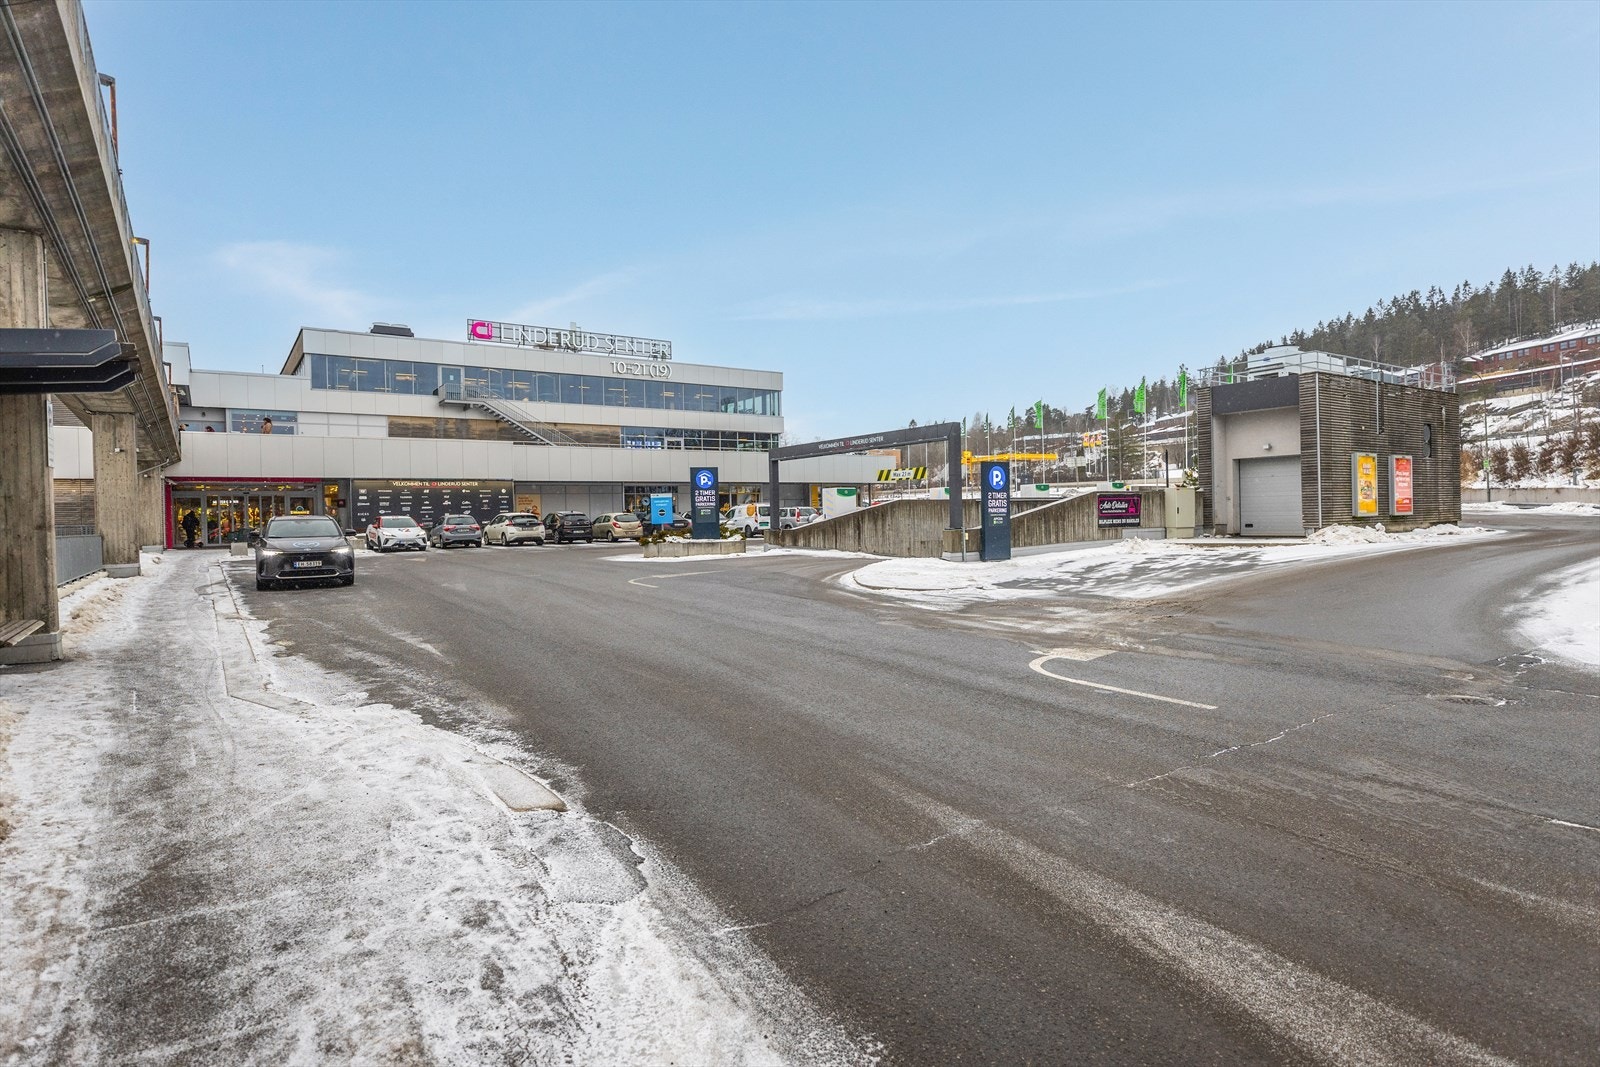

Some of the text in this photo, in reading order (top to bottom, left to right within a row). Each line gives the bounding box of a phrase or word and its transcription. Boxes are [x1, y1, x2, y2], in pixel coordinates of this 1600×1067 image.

[500, 323, 670, 357] LINDERUD SENTER
[610, 360, 672, 379] 10-21 (19)
[850, 438, 868, 446] LINDERUD
